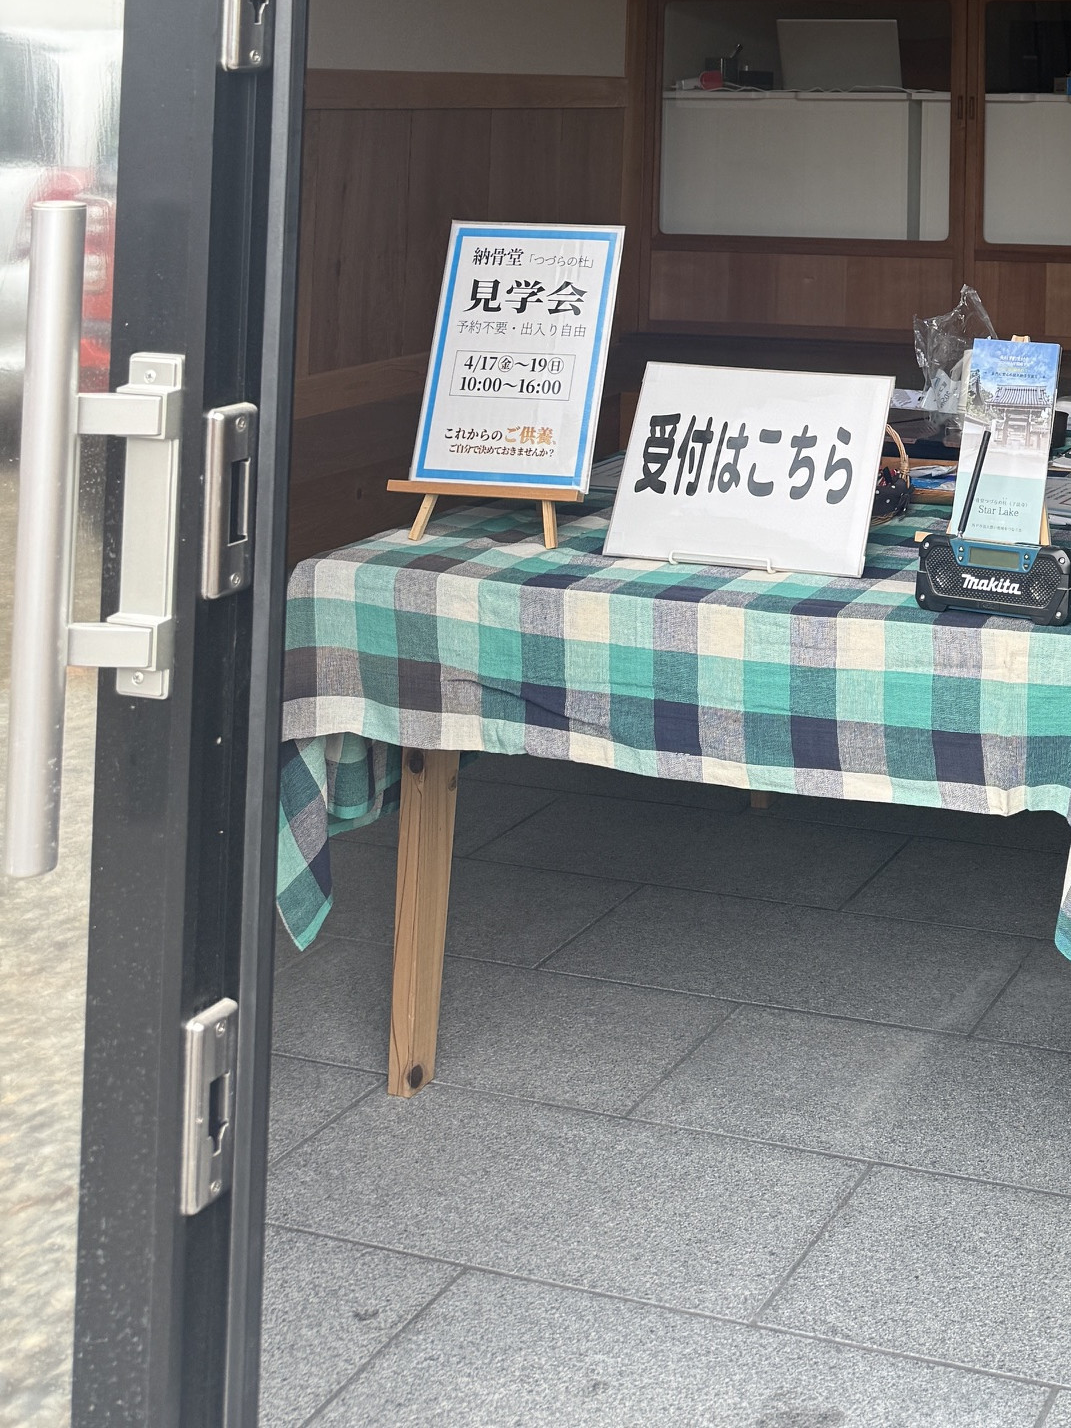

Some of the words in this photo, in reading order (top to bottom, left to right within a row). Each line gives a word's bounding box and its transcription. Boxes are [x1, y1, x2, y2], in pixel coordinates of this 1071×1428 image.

[472, 247, 524, 266] 納骨堂
[529, 253, 594, 269] 「つづらの杜」
[463, 278, 587, 316] 見学会
[456, 320, 586, 338] 予約不要・出入り自由
[634, 413, 853, 505] 受付はこちら
[978, 504, 996, 515] Star
[998, 506, 1019, 517] Lake
